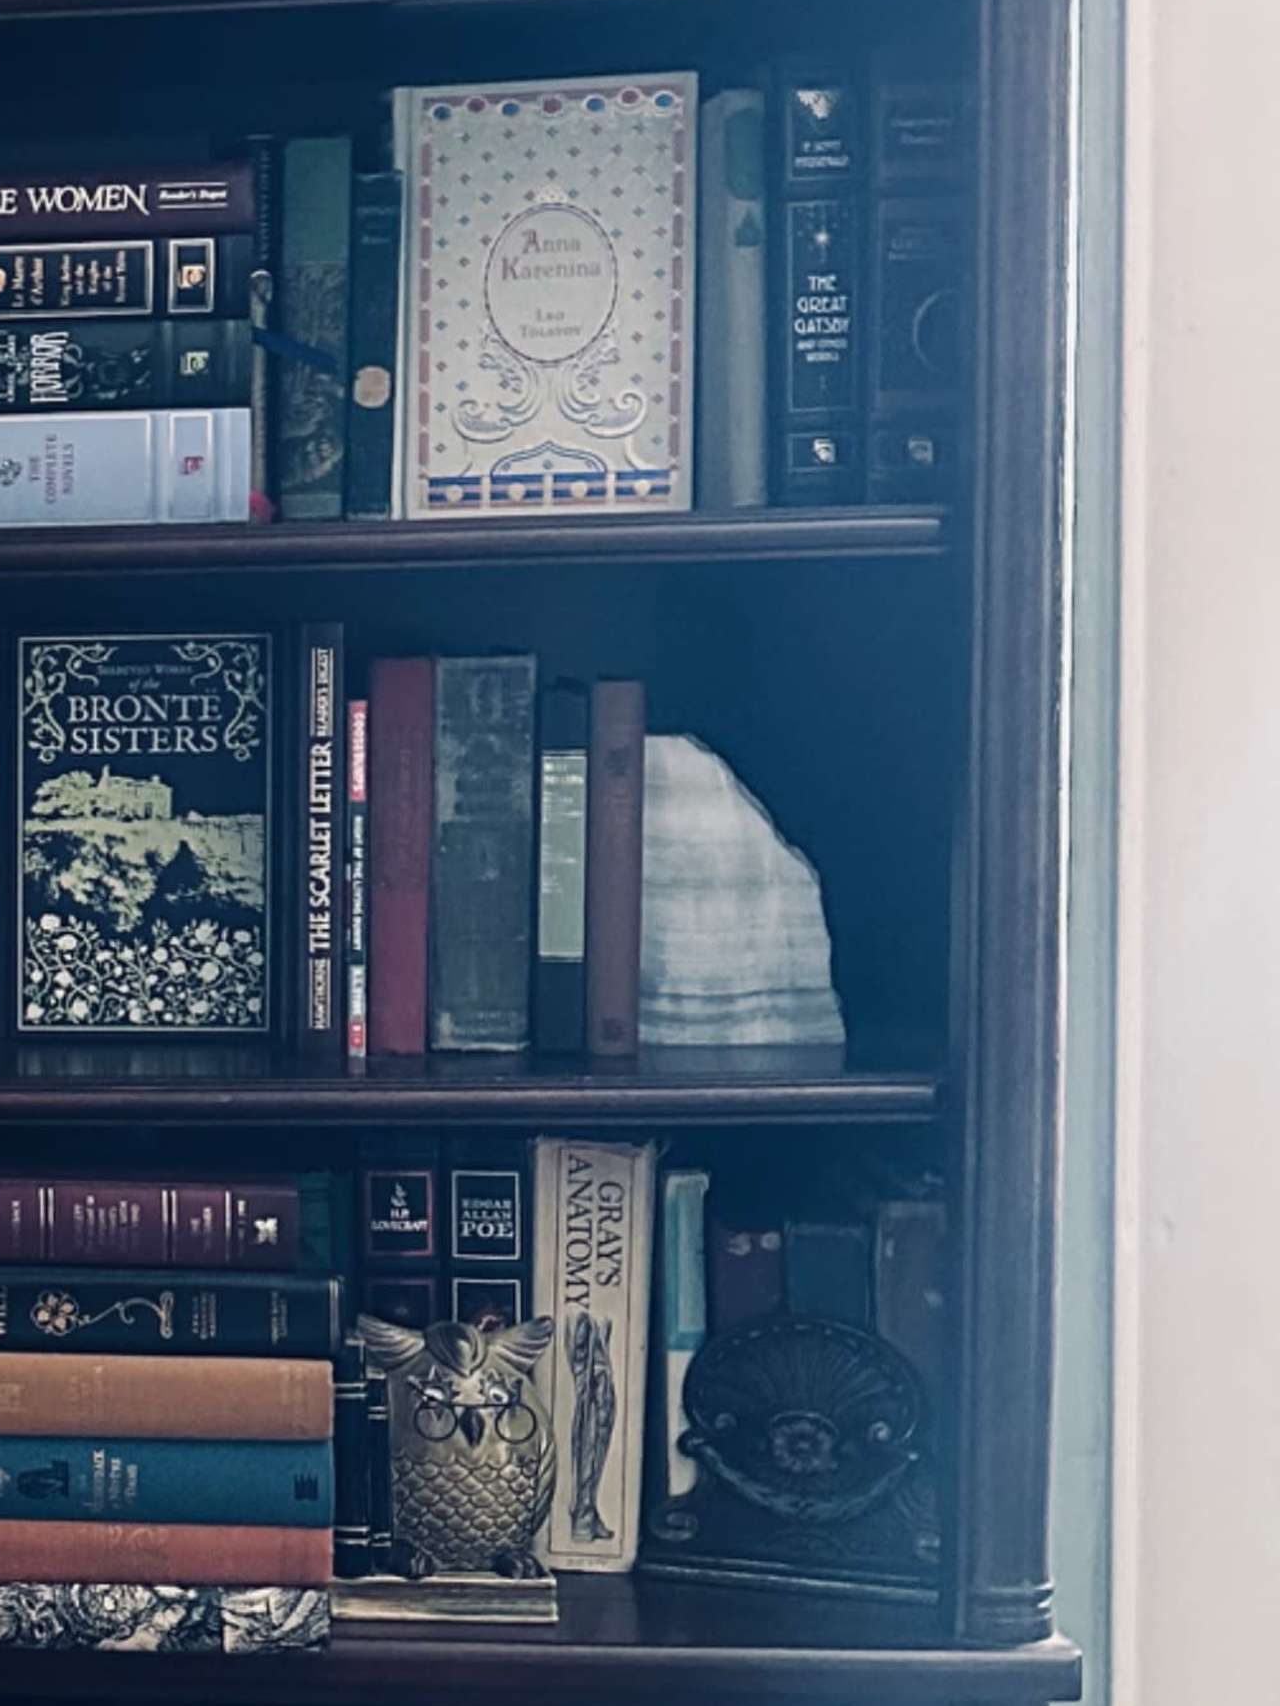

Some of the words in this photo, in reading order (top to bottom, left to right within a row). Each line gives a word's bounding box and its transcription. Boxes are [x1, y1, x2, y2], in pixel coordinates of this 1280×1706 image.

[26, 183, 152, 216] WOMEN
[521, 228, 582, 254] Anna
[501, 256, 602, 280] Karenina
[807, 274, 837, 292] THE
[796, 295, 848, 313] GREAT
[794, 317, 851, 335] GATSBY
[29, 331, 70, 404] HORROR
[66, 687, 223, 723] BRONTË
[69, 725, 219, 755] SISTERS
[311, 742, 333, 814] LETTER
[310, 817, 332, 908] SCARLET
[309, 911, 332, 952] THE
[314, 959, 327, 1029] HAWTHORNE
[461, 1197, 513, 1209] EDGAR
[461, 1209, 513, 1221] ALLAN
[370, 1219, 429, 1233] LOVECRAFT
[459, 1219, 515, 1239] POE
[563, 1153, 596, 1311] ANATOMY
[595, 1179, 627, 1289] GRAY'S
